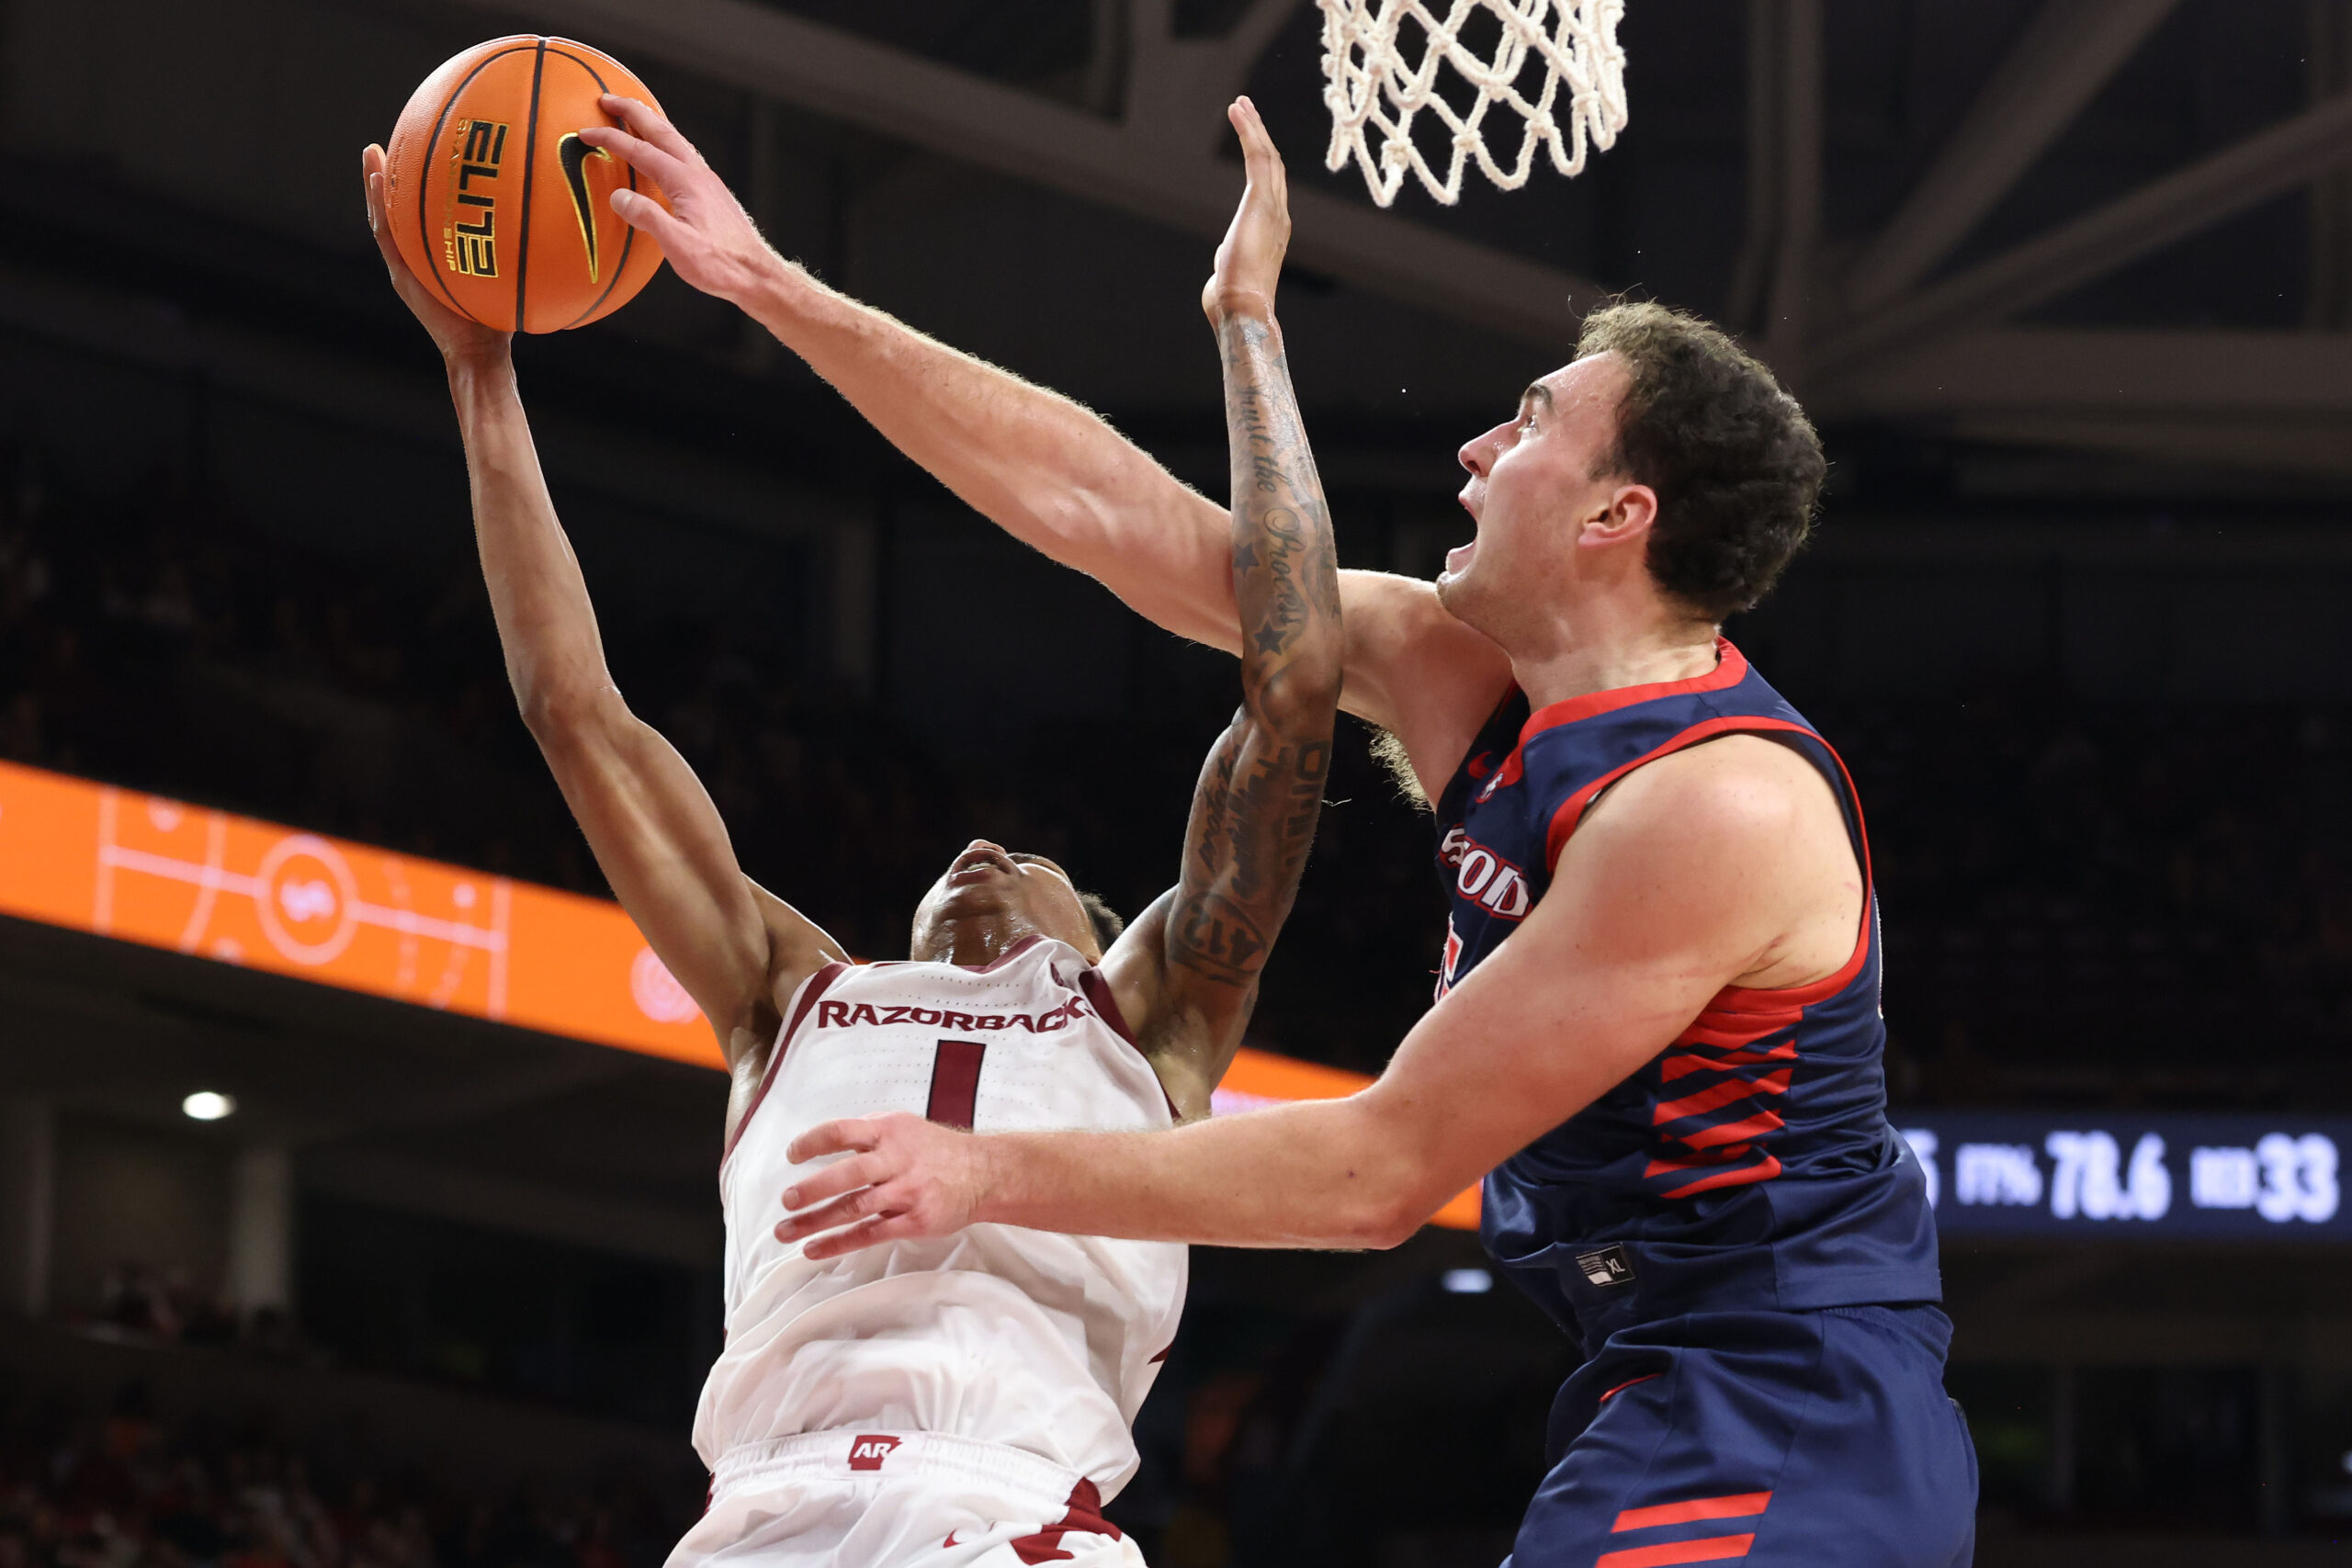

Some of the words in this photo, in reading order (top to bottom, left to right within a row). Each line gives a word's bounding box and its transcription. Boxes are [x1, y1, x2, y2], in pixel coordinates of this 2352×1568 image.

[455, 119, 510, 277] ELITE
[1254, 453, 1291, 494] the
[1262, 506, 1308, 626] Process
[818, 995, 1095, 1033] RAZORBACK
[926, 1039, 987, 1133] 1
[2045, 1129, 2172, 1221] 78.6
[2255, 1131, 2340, 1223] 33
[1605, 1258, 1626, 1275] XL
[853, 1442, 891, 1459] AR
